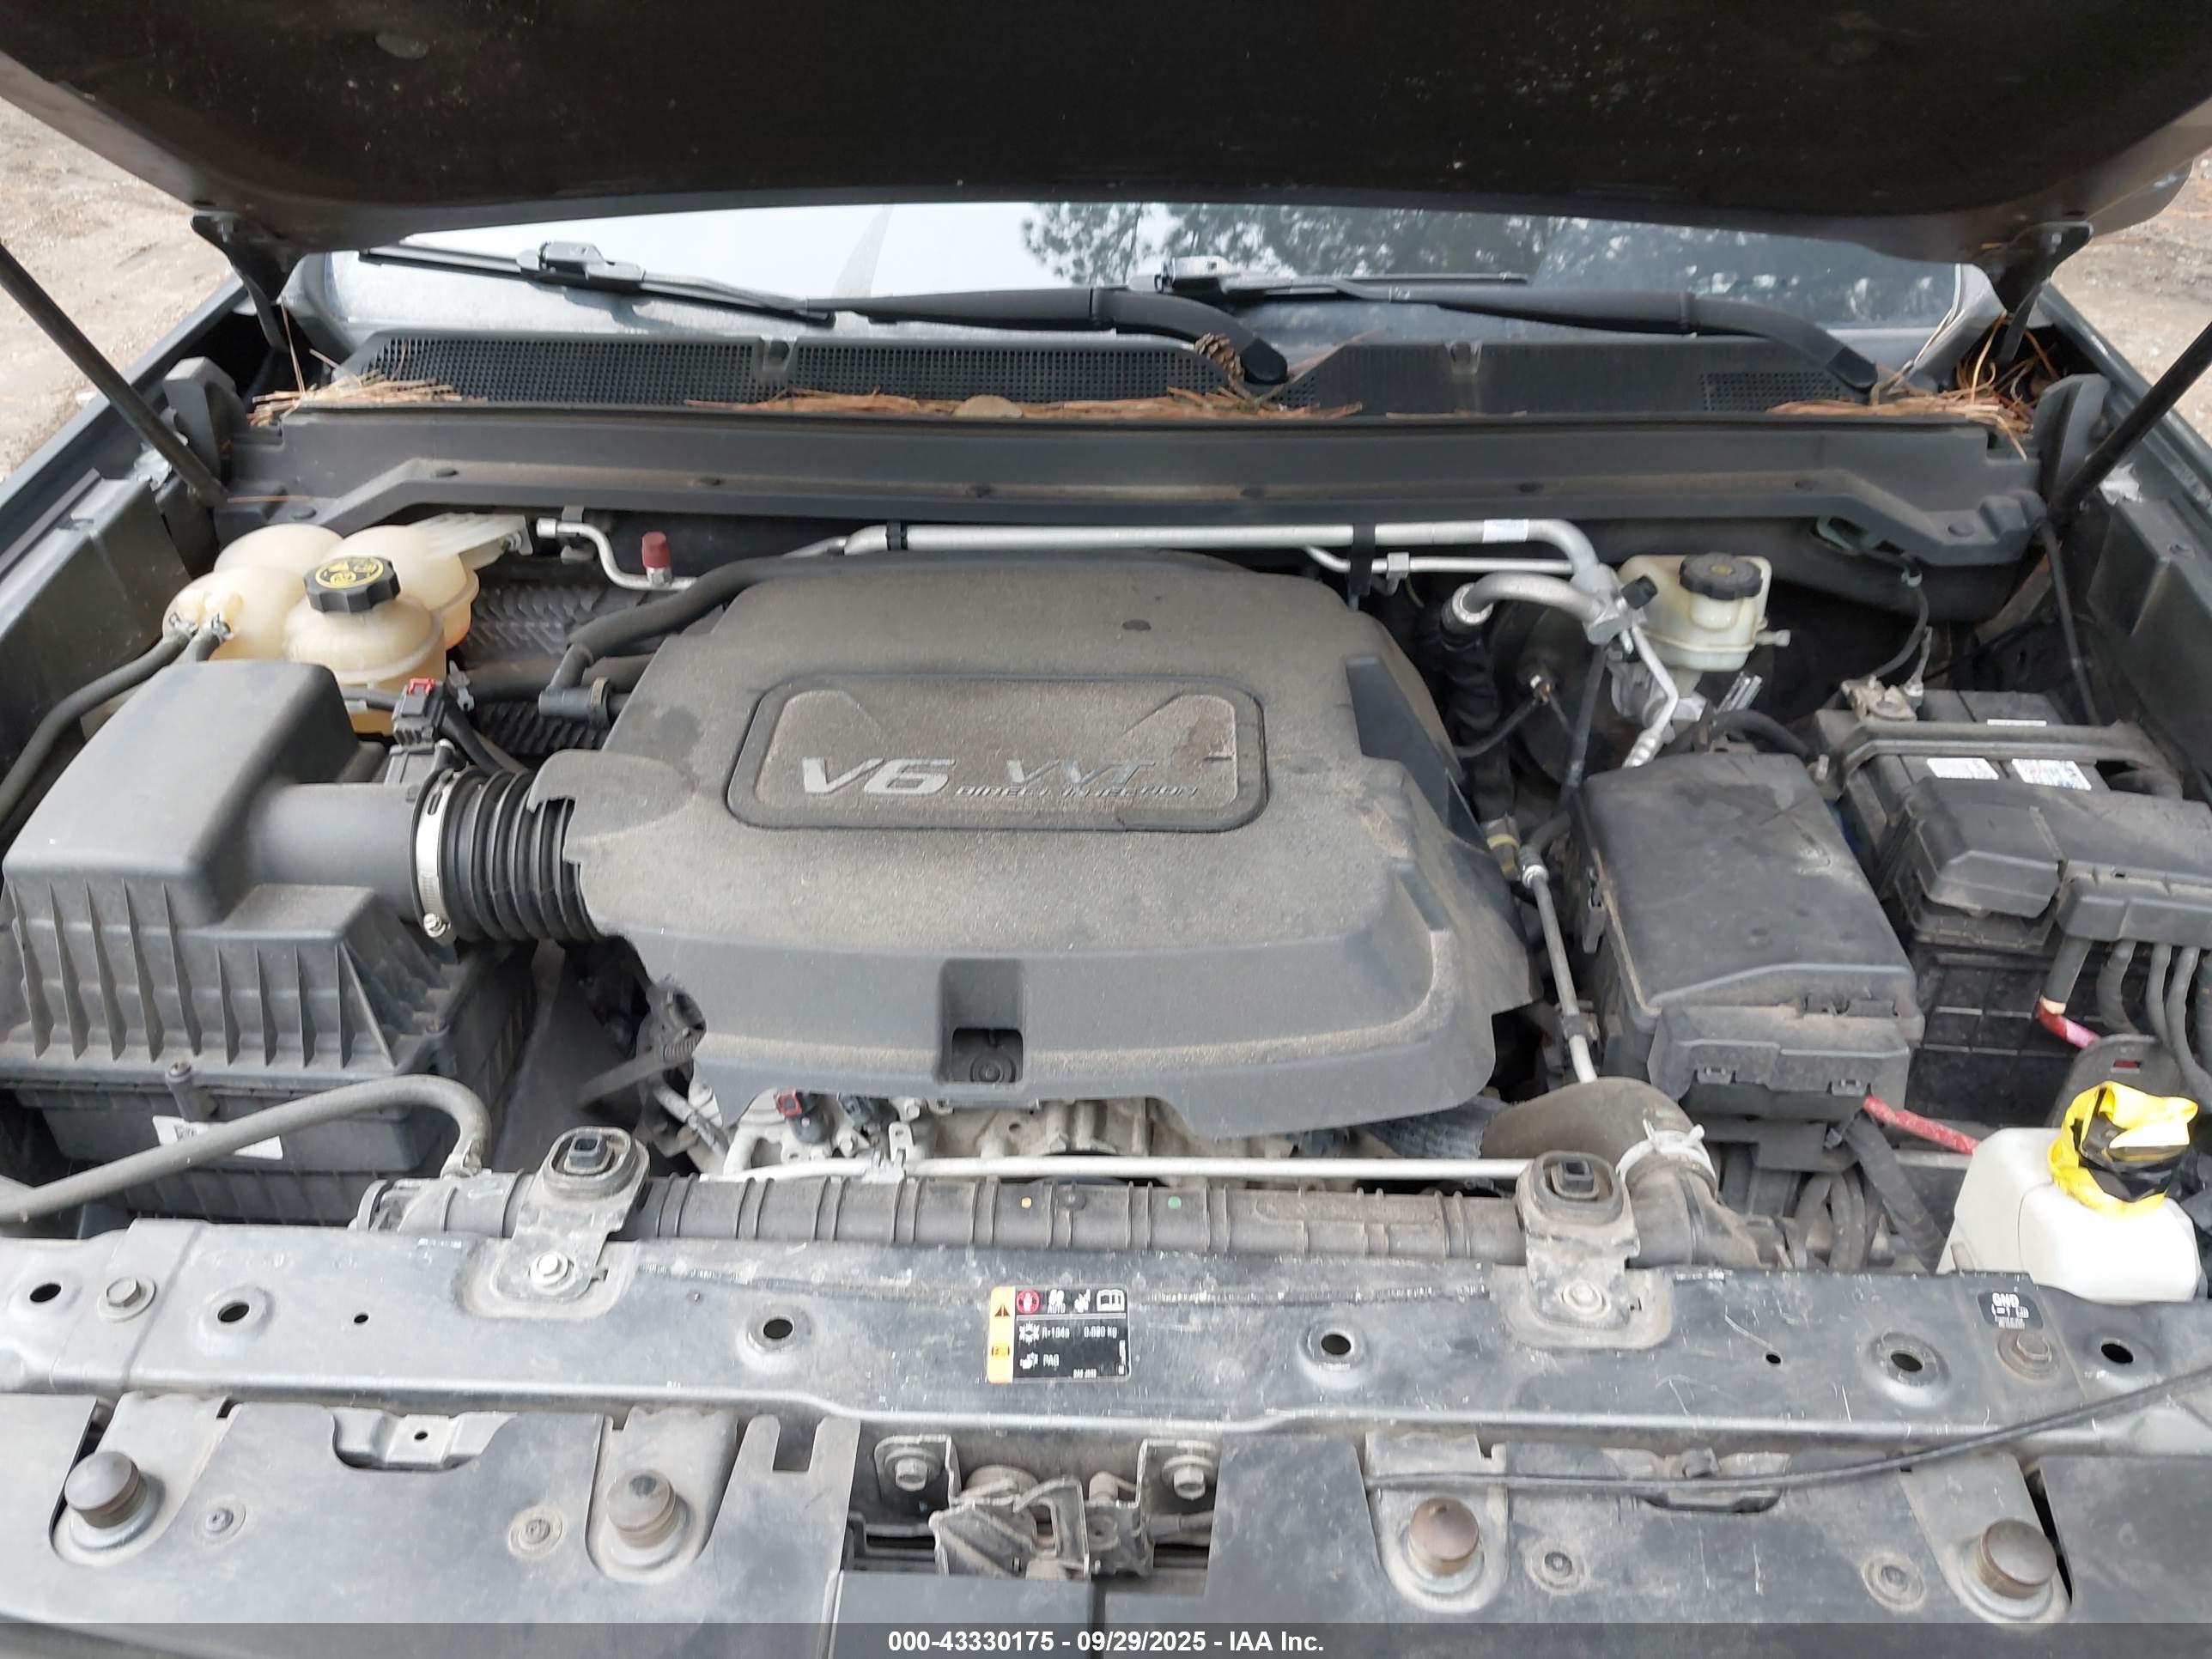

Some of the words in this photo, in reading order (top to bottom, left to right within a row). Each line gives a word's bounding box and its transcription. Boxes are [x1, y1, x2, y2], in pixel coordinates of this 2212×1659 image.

[802, 757, 956, 794] V6
[1006, 759, 1156, 784] VVT
[1992, 1292, 2020, 1308] GND
